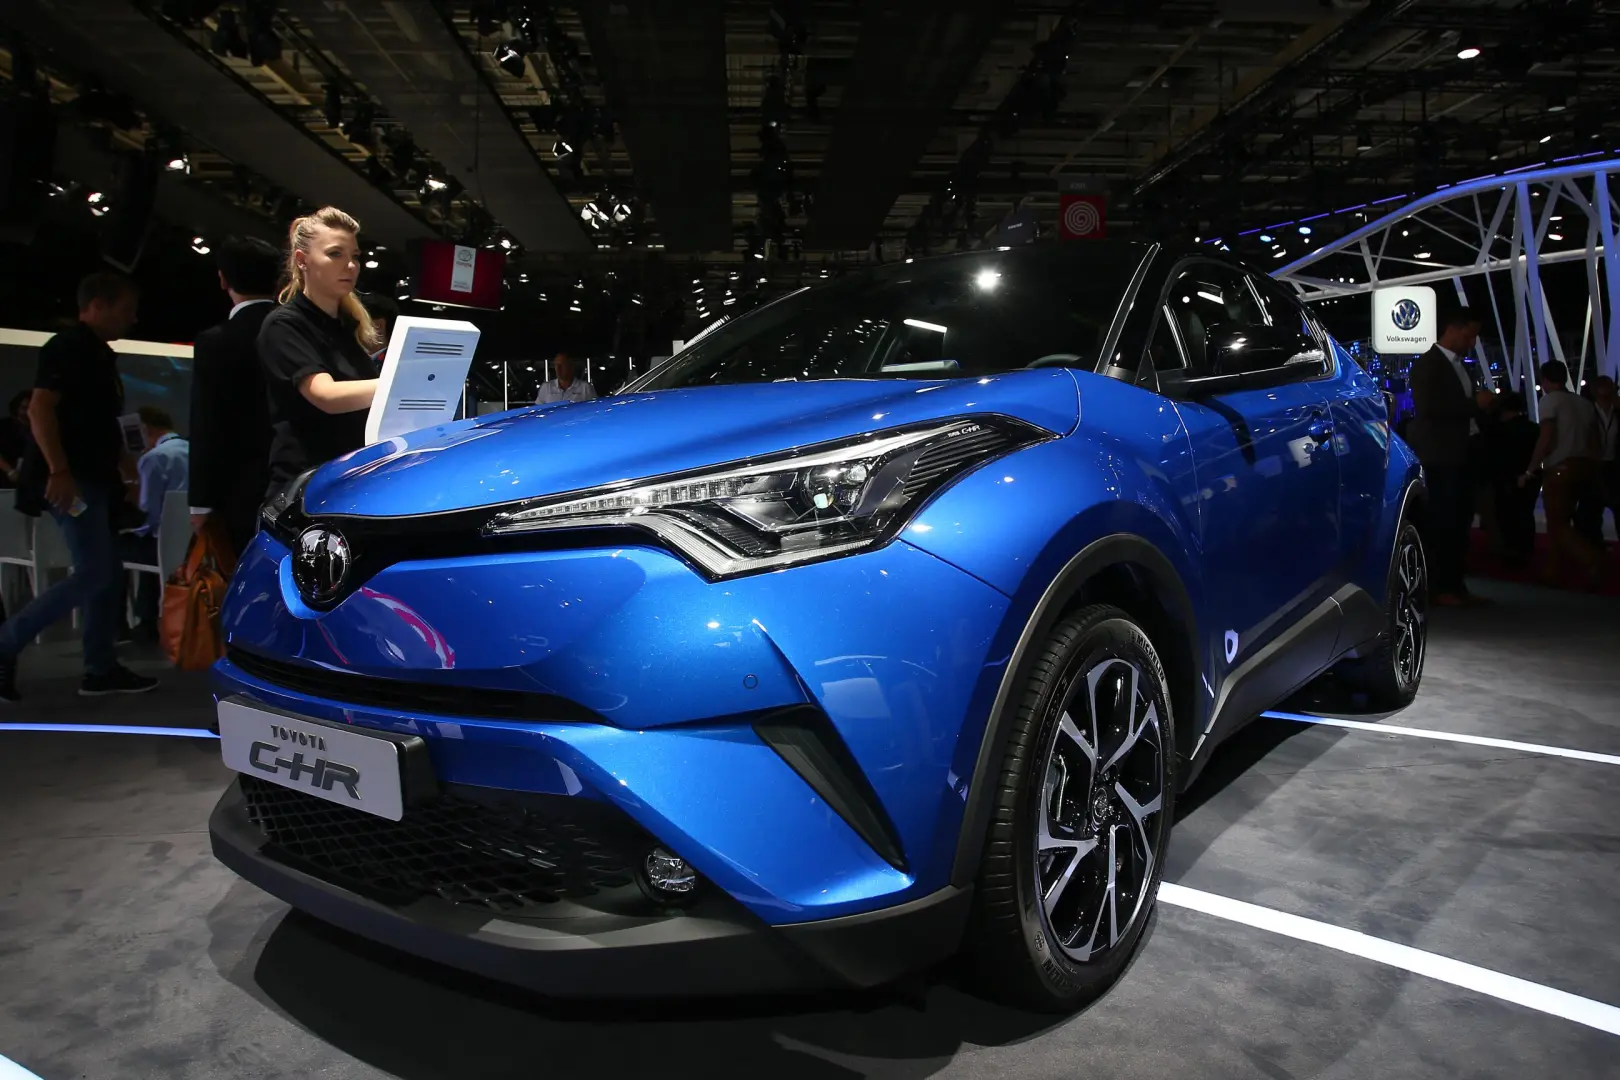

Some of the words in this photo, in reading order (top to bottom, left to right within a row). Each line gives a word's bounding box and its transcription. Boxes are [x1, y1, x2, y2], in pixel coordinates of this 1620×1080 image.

[1386, 335, 1427, 343] Volkswagen
[270, 724, 326, 751] TOYOTA
[249, 741, 361, 799] C-HR
